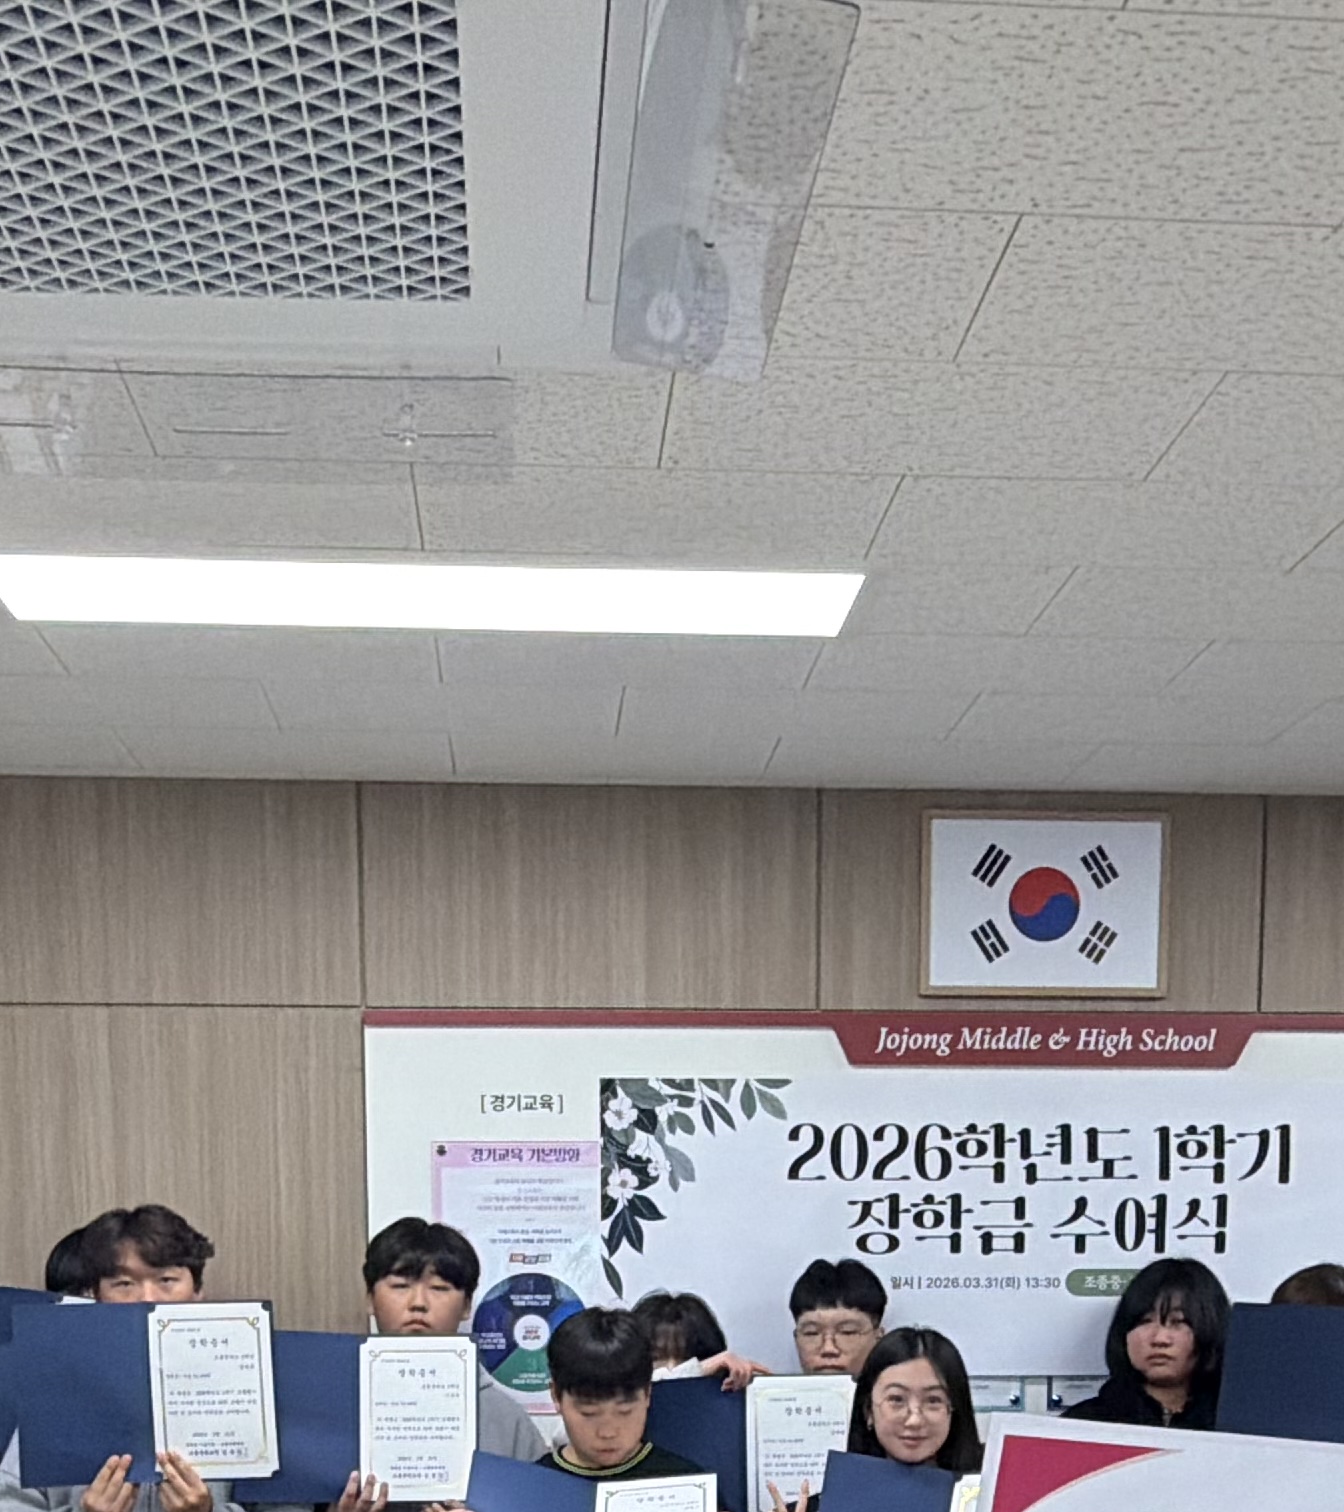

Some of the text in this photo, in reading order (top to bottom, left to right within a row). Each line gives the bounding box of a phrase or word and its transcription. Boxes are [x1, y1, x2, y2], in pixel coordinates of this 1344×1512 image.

[875, 1027, 1217, 1055] Jojong Middle & High School
[470, 1147, 524, 1163] 경기교육
[787, 1121, 1292, 1185] 2026학년도 1학기
[847, 1192, 1230, 1256] 장학금 수여식
[890, 1276, 915, 1290] 일시
[926, 1276, 1021, 1291] 2026.03.31(화)
[1026, 1277, 1061, 1290] 13:30
